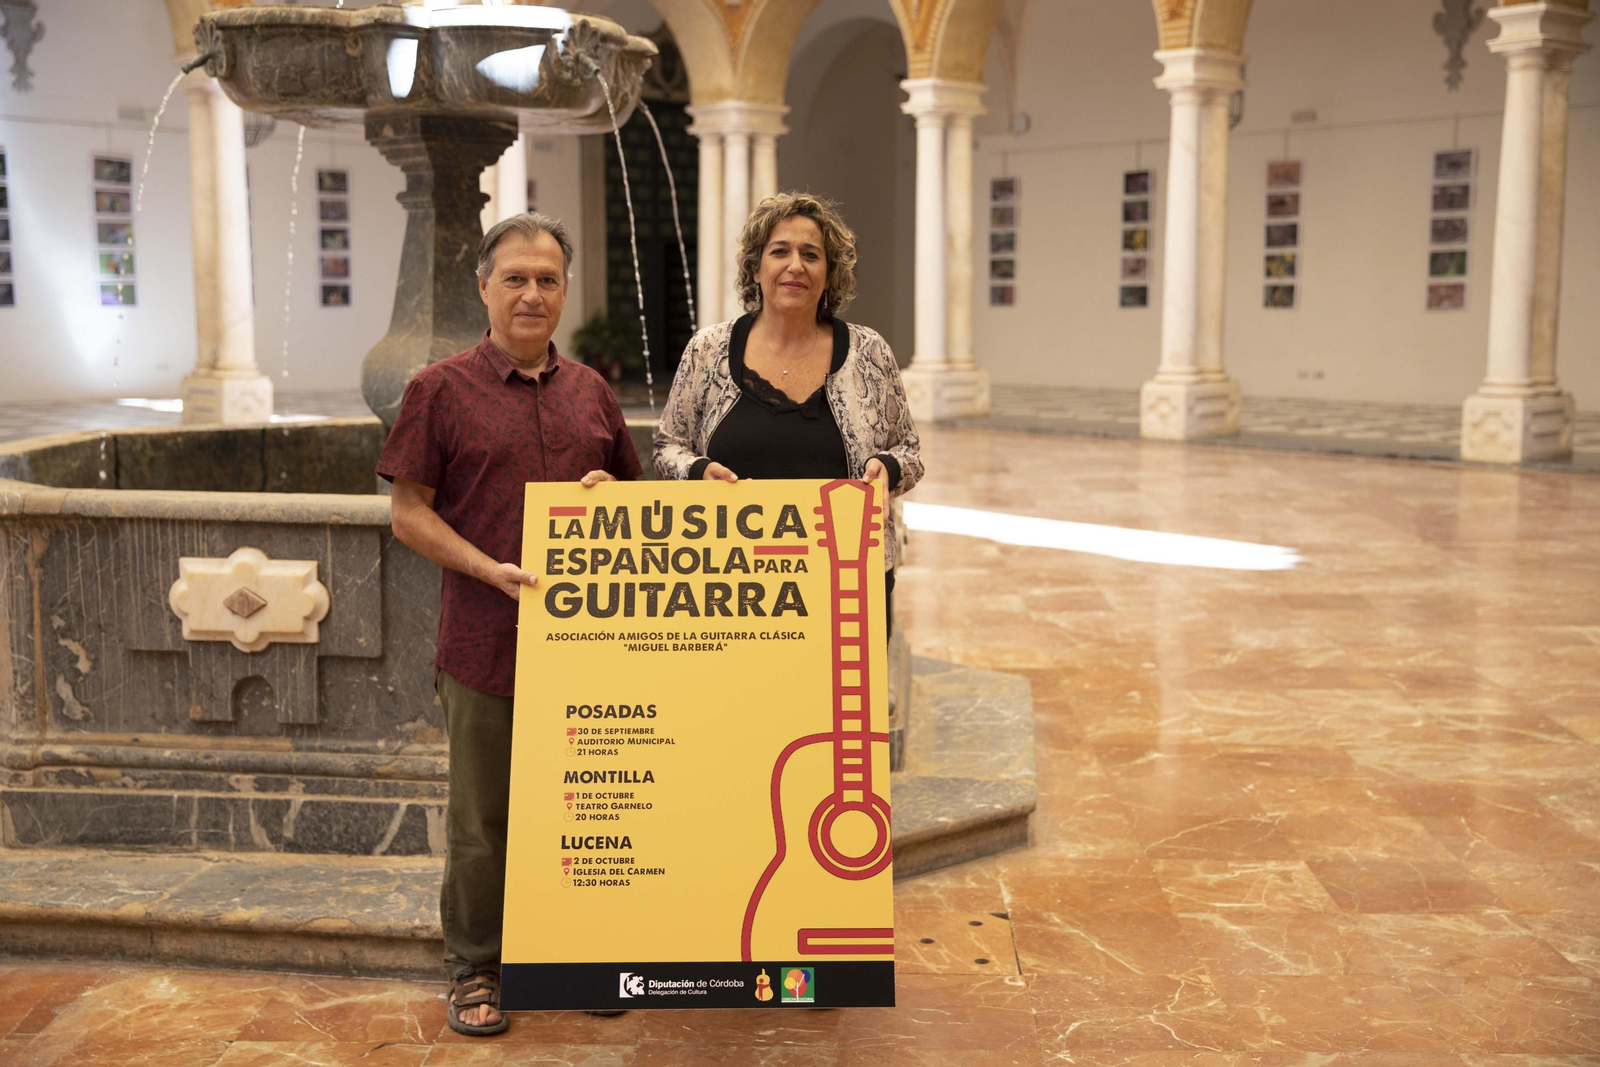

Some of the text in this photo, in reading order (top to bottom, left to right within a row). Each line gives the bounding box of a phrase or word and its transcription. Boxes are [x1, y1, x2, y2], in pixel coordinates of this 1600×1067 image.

[548, 499, 808, 540] LA MÚSICA
[545, 542, 809, 575] ESPAÑOLA PARA
[544, 581, 809, 619] GUITARRA
[546, 630, 805, 641] ASOCIACIÓN AMIGOS DE LA GUITARRA CLÁSICA
[623, 641, 728, 652] "MIGUEL BARBERÁ"
[566, 704, 657, 719] POSADAS
[604, 727, 655, 735] SEPTIEMBRE
[577, 748, 586, 756] 21
[563, 770, 655, 784] MONTILLA
[611, 802, 653, 810] GARNELO
[575, 813, 587, 821] 20
[561, 835, 632, 850] LUCENA
[573, 868, 607, 876] IGLESIA
[627, 867, 665, 875] CARMEN
[573, 879, 597, 887] 12:30
[648, 979, 744, 989] Diputación de Córdoba
